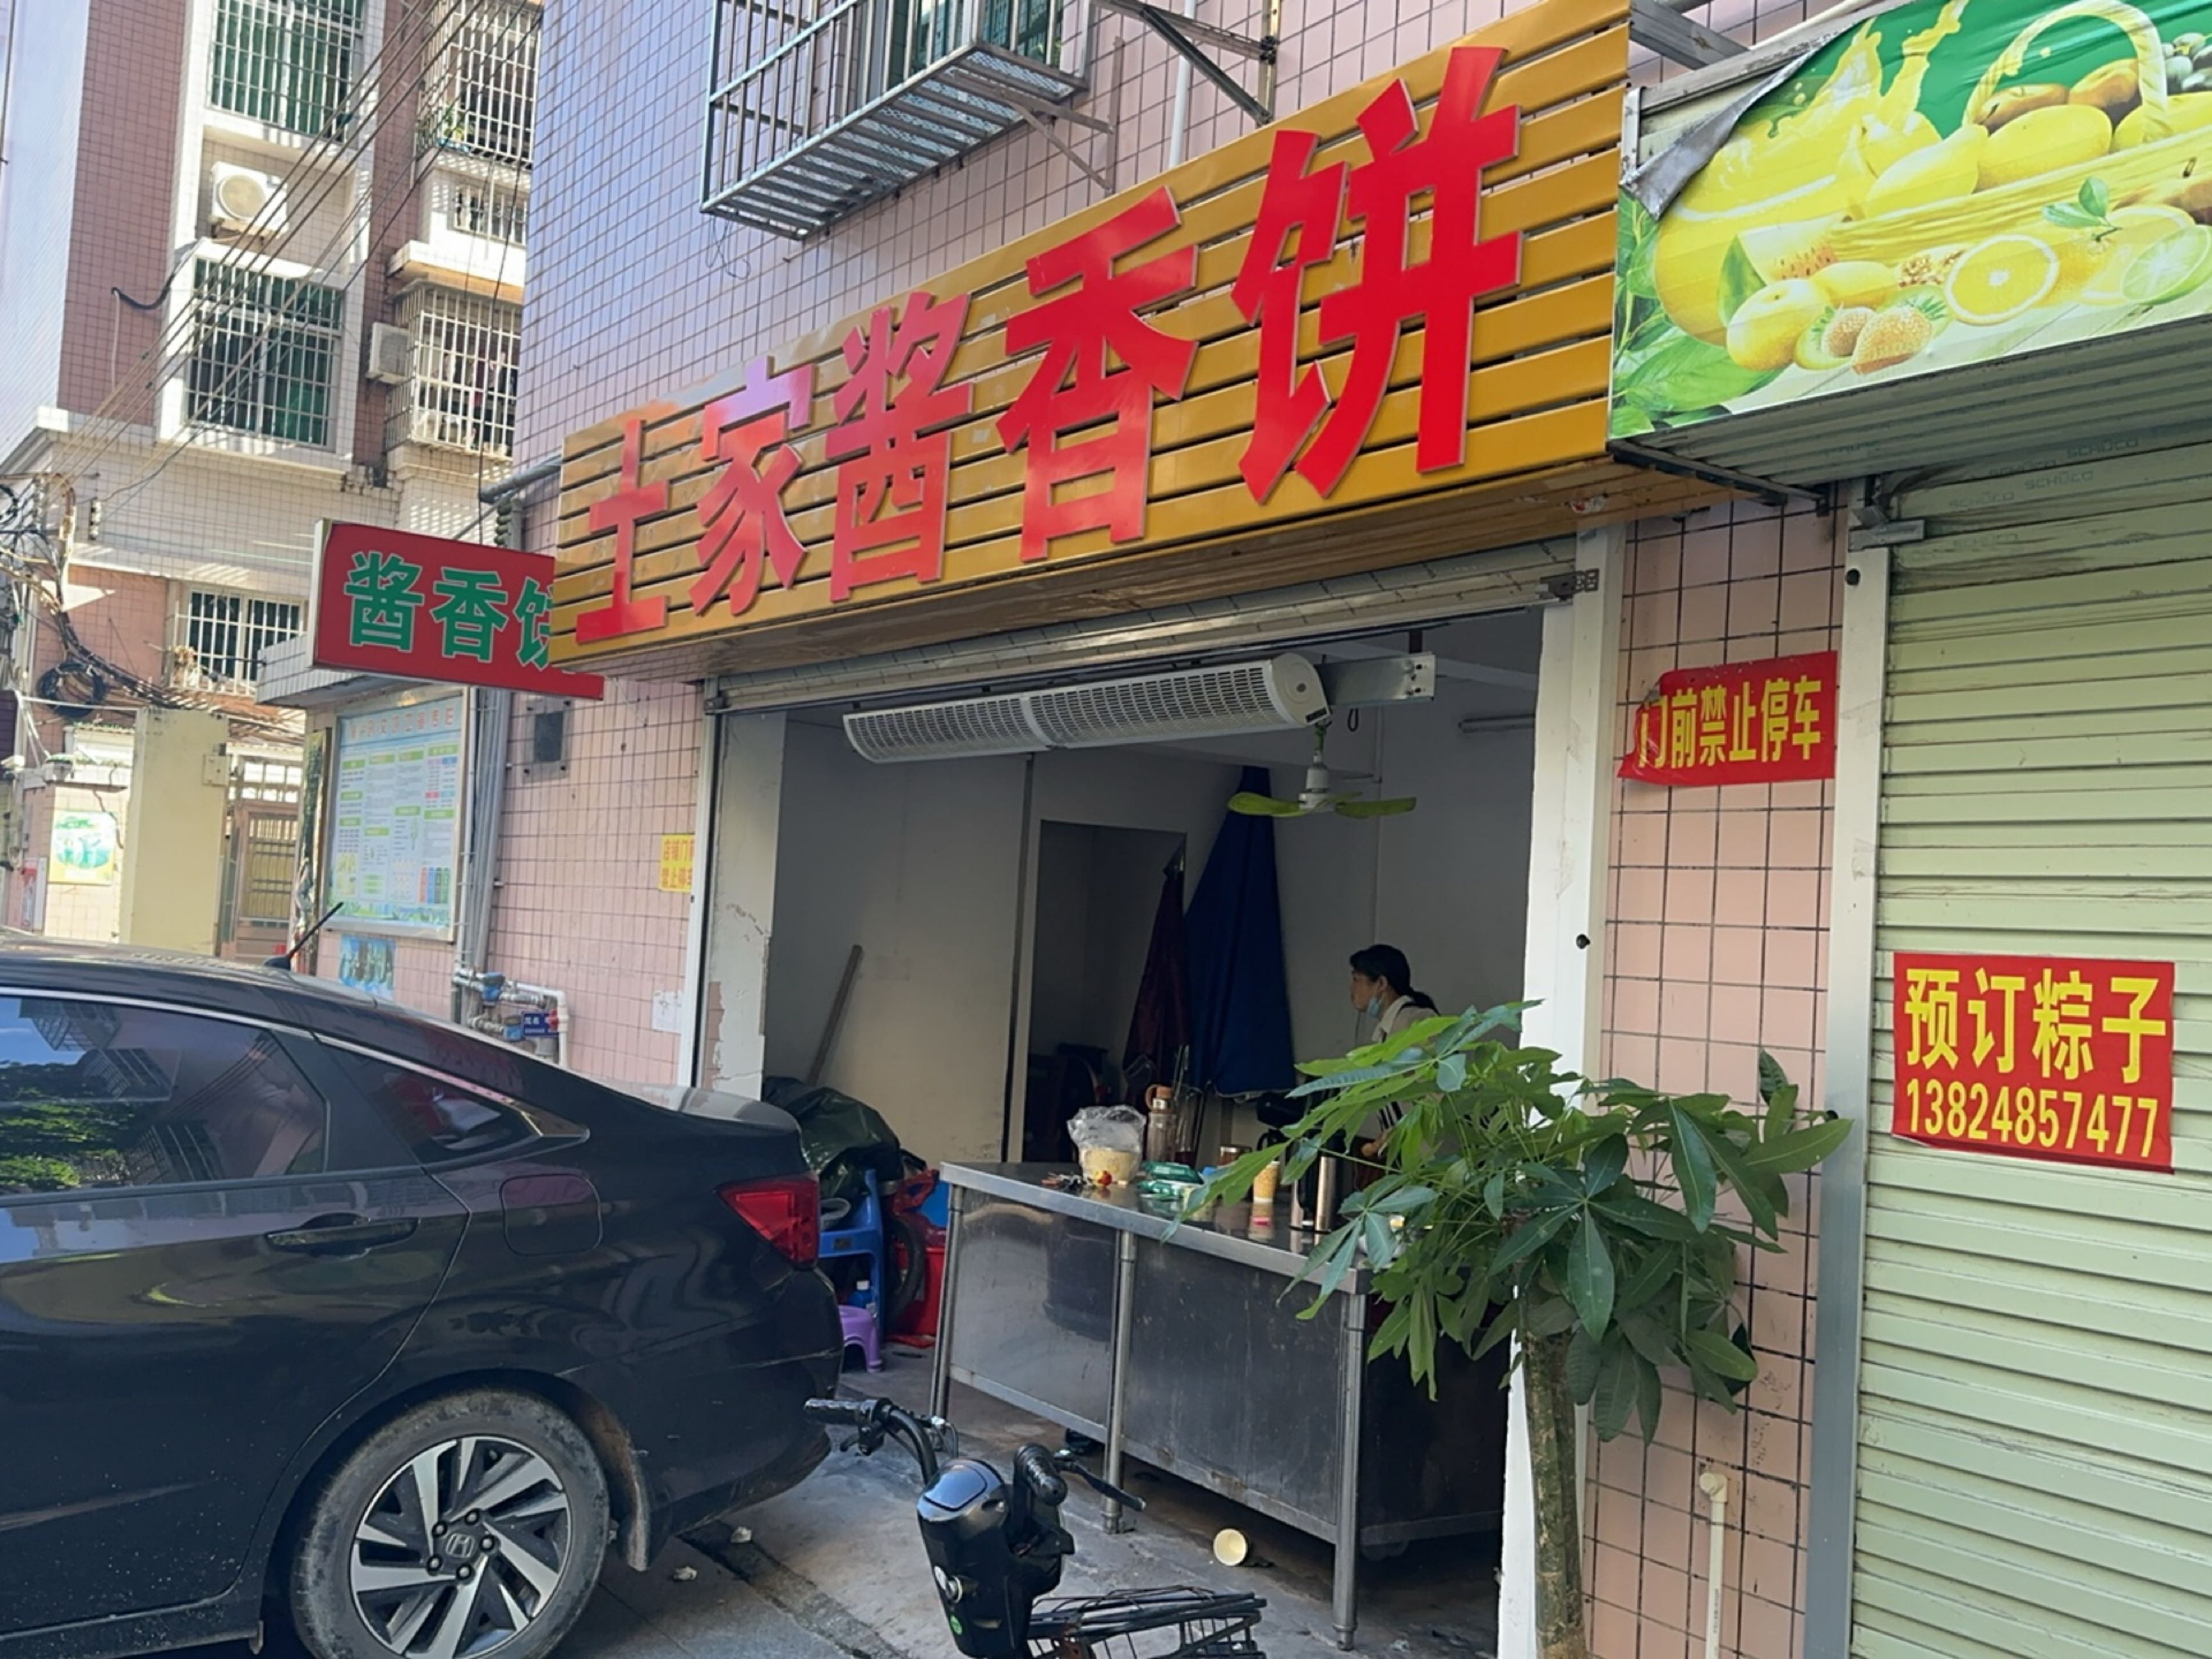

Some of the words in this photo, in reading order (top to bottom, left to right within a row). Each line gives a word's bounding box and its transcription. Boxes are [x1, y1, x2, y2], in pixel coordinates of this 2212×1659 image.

[576, 47, 1522, 643] 土家酱香饼
[1638, 675, 1822, 768] 门前禁止停车
[1904, 967, 2167, 1084] 预订粽子
[1907, 1078, 2158, 1157] 13824857477
